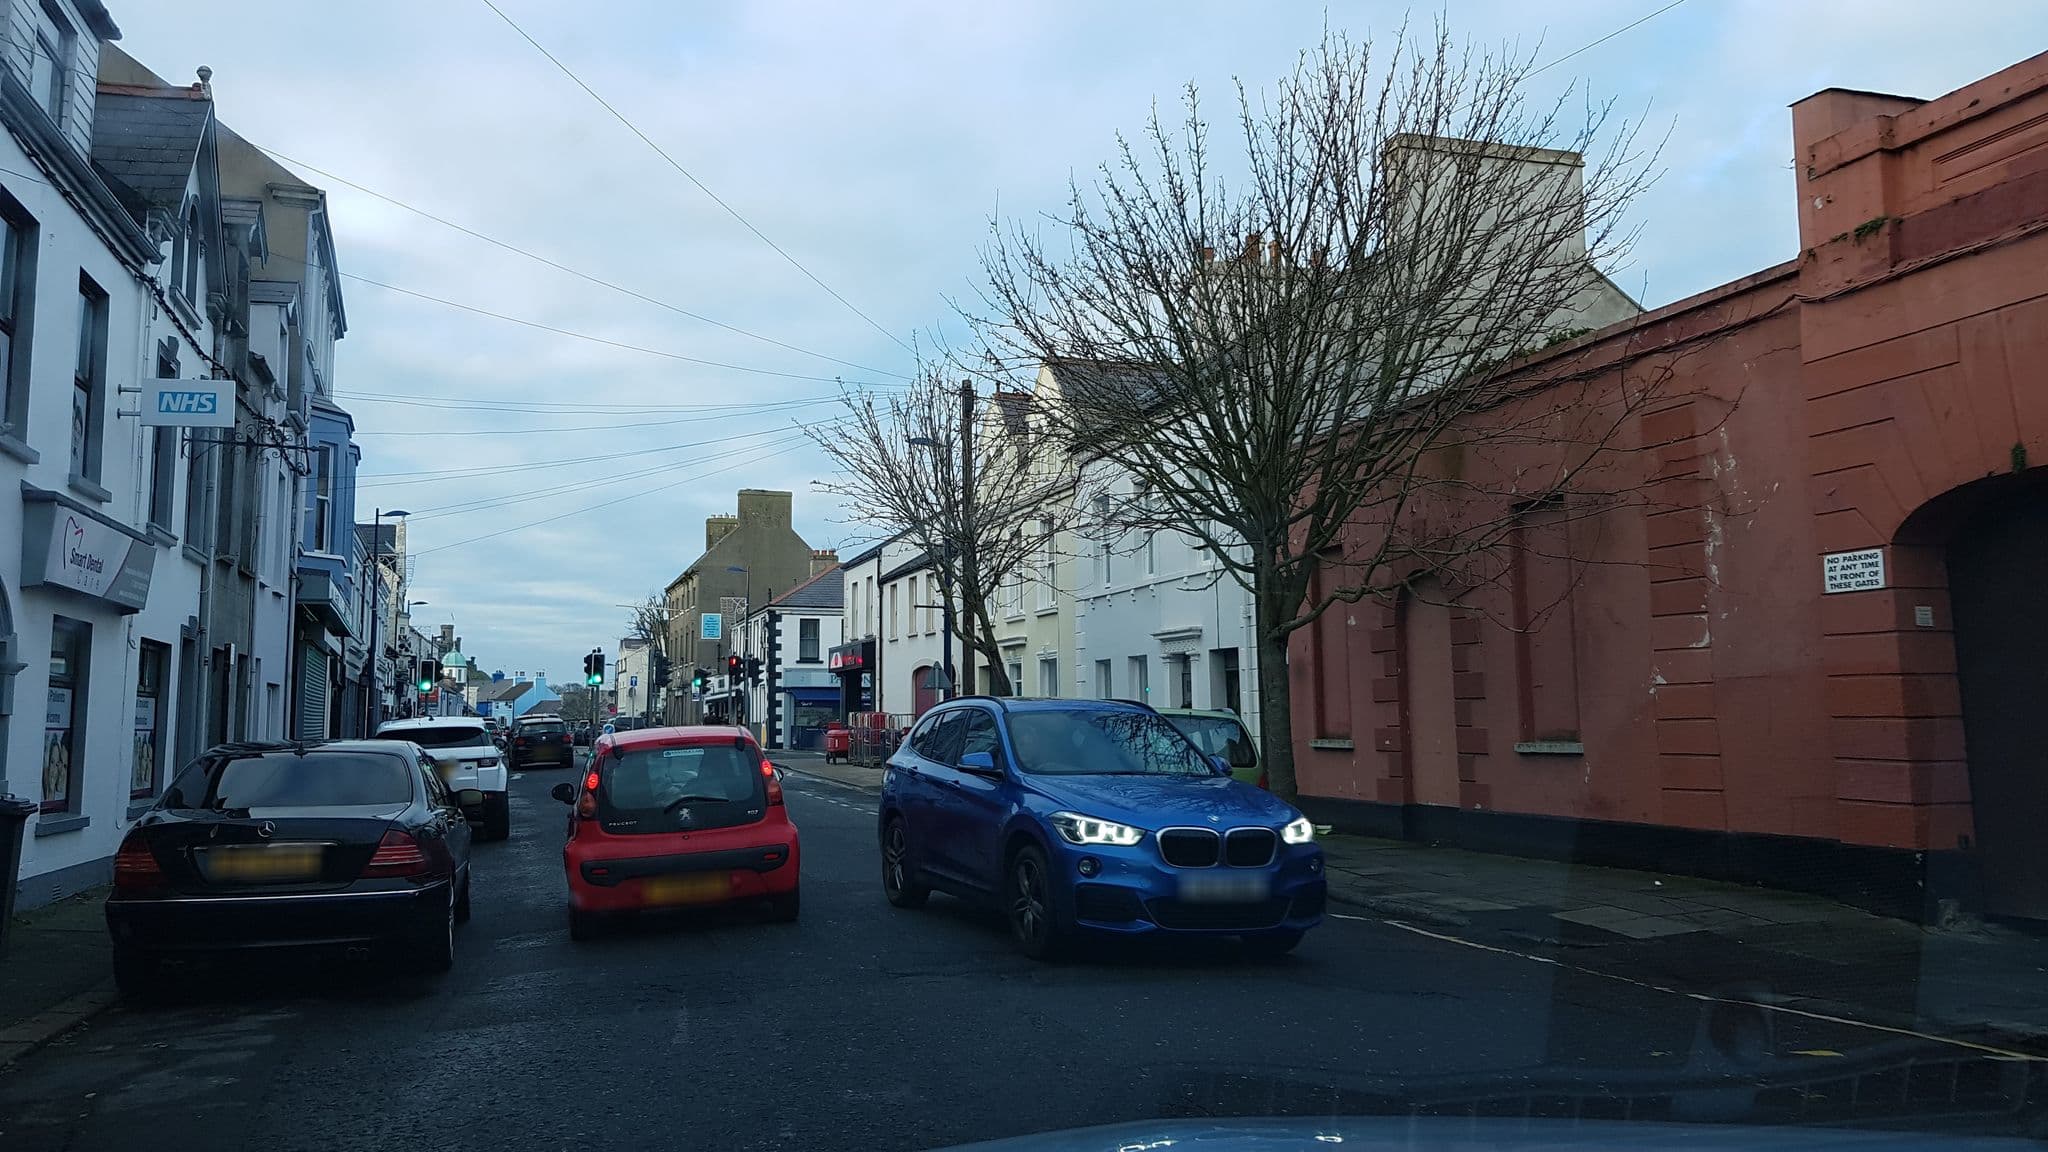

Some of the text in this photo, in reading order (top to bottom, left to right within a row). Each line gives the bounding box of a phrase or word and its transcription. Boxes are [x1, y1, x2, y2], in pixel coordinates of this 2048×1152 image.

[160, 393, 214, 412] NHS
[70, 547, 87, 568] Smart
[87, 554, 104, 574] Dental
[1843, 553, 1879, 562] PARKING
[1861, 561, 1880, 569] TIME
[1840, 572, 1865, 580] FRONT
[1830, 579, 1880, 590] THESE GATES
